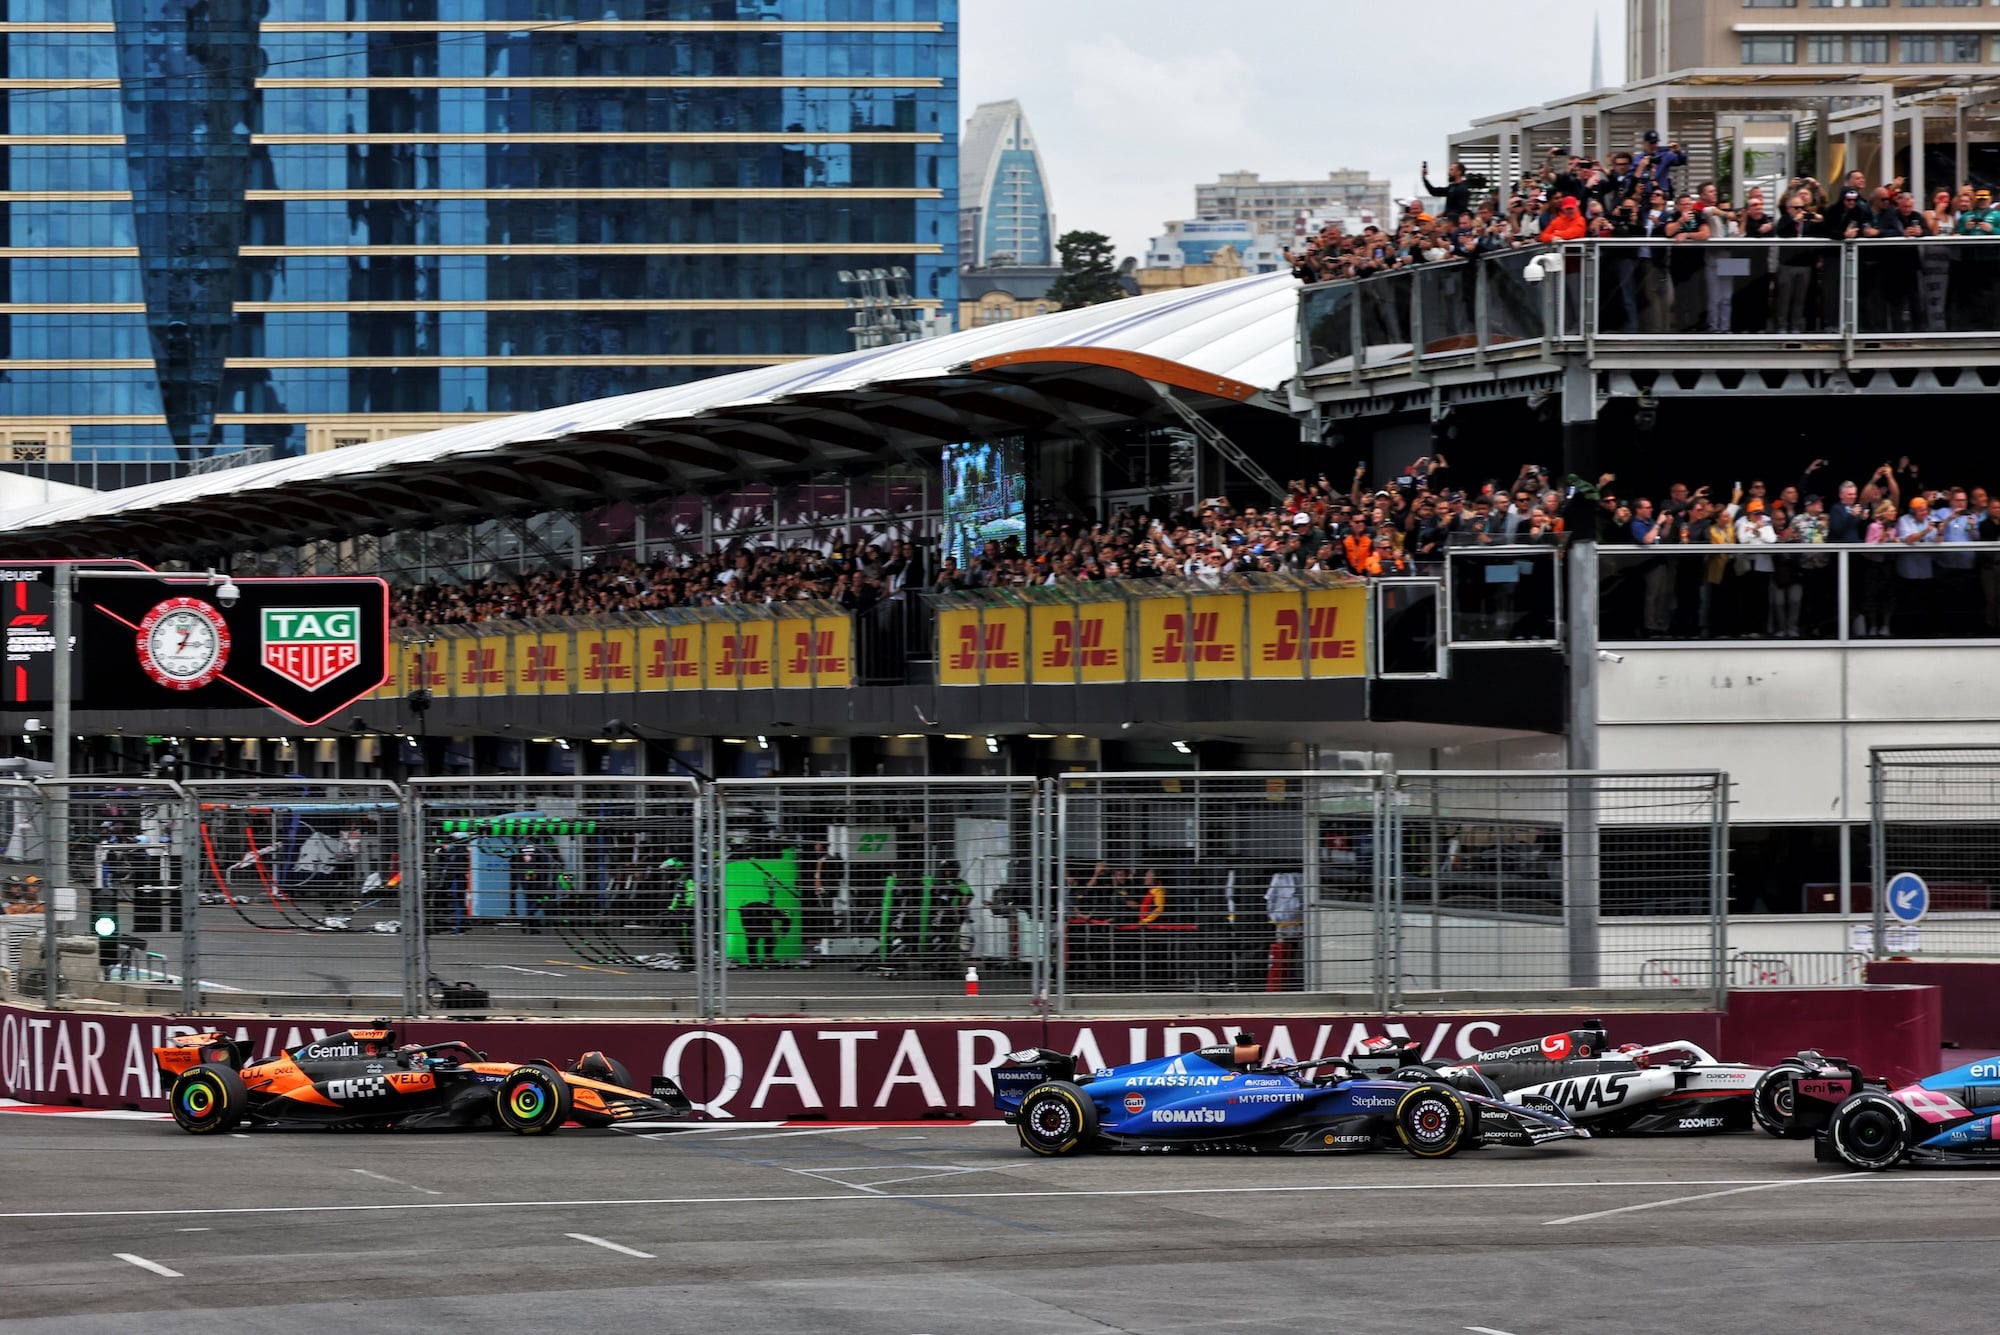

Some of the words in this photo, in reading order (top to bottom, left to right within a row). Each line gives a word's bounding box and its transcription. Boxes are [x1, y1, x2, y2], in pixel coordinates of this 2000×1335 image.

[269, 614, 351, 638] TAG
[1160, 612, 1226, 664] DHL
[1270, 607, 1347, 661] DHL
[956, 624, 1011, 669] DHL
[1050, 619, 1109, 668] DHL
[268, 646, 354, 683] HEUER
[2, 1014, 109, 1096] QATAR
[308, 1042, 359, 1058] Gemini
[1477, 1043, 1539, 1062] MoneyGram
[391, 1074, 430, 1084] VELO
[662, 1029, 1013, 1119] QATAR
[998, 1071, 1042, 1080] KOMATSU
[1097, 1068, 1115, 1077] 23
[1405, 1070, 1428, 1079] ZER
[328, 1076, 387, 1100] OKX
[1125, 1075, 1219, 1087] ATLASSIAN
[1804, 1082, 1825, 1093] eni
[1239, 1093, 1305, 1104] MYPROTEIN
[1536, 1072, 1643, 1112] HAAS
[1125, 1098, 1145, 1107] Gulf
[1351, 1095, 1397, 1108] Stephens
[1534, 1103, 1554, 1111] airia
[1151, 1107, 1226, 1123] KOMATSU
[1481, 1111, 1509, 1120] betway
[1678, 1117, 1724, 1129] ZOOMEX
[1334, 1135, 1371, 1143] KEEPER
